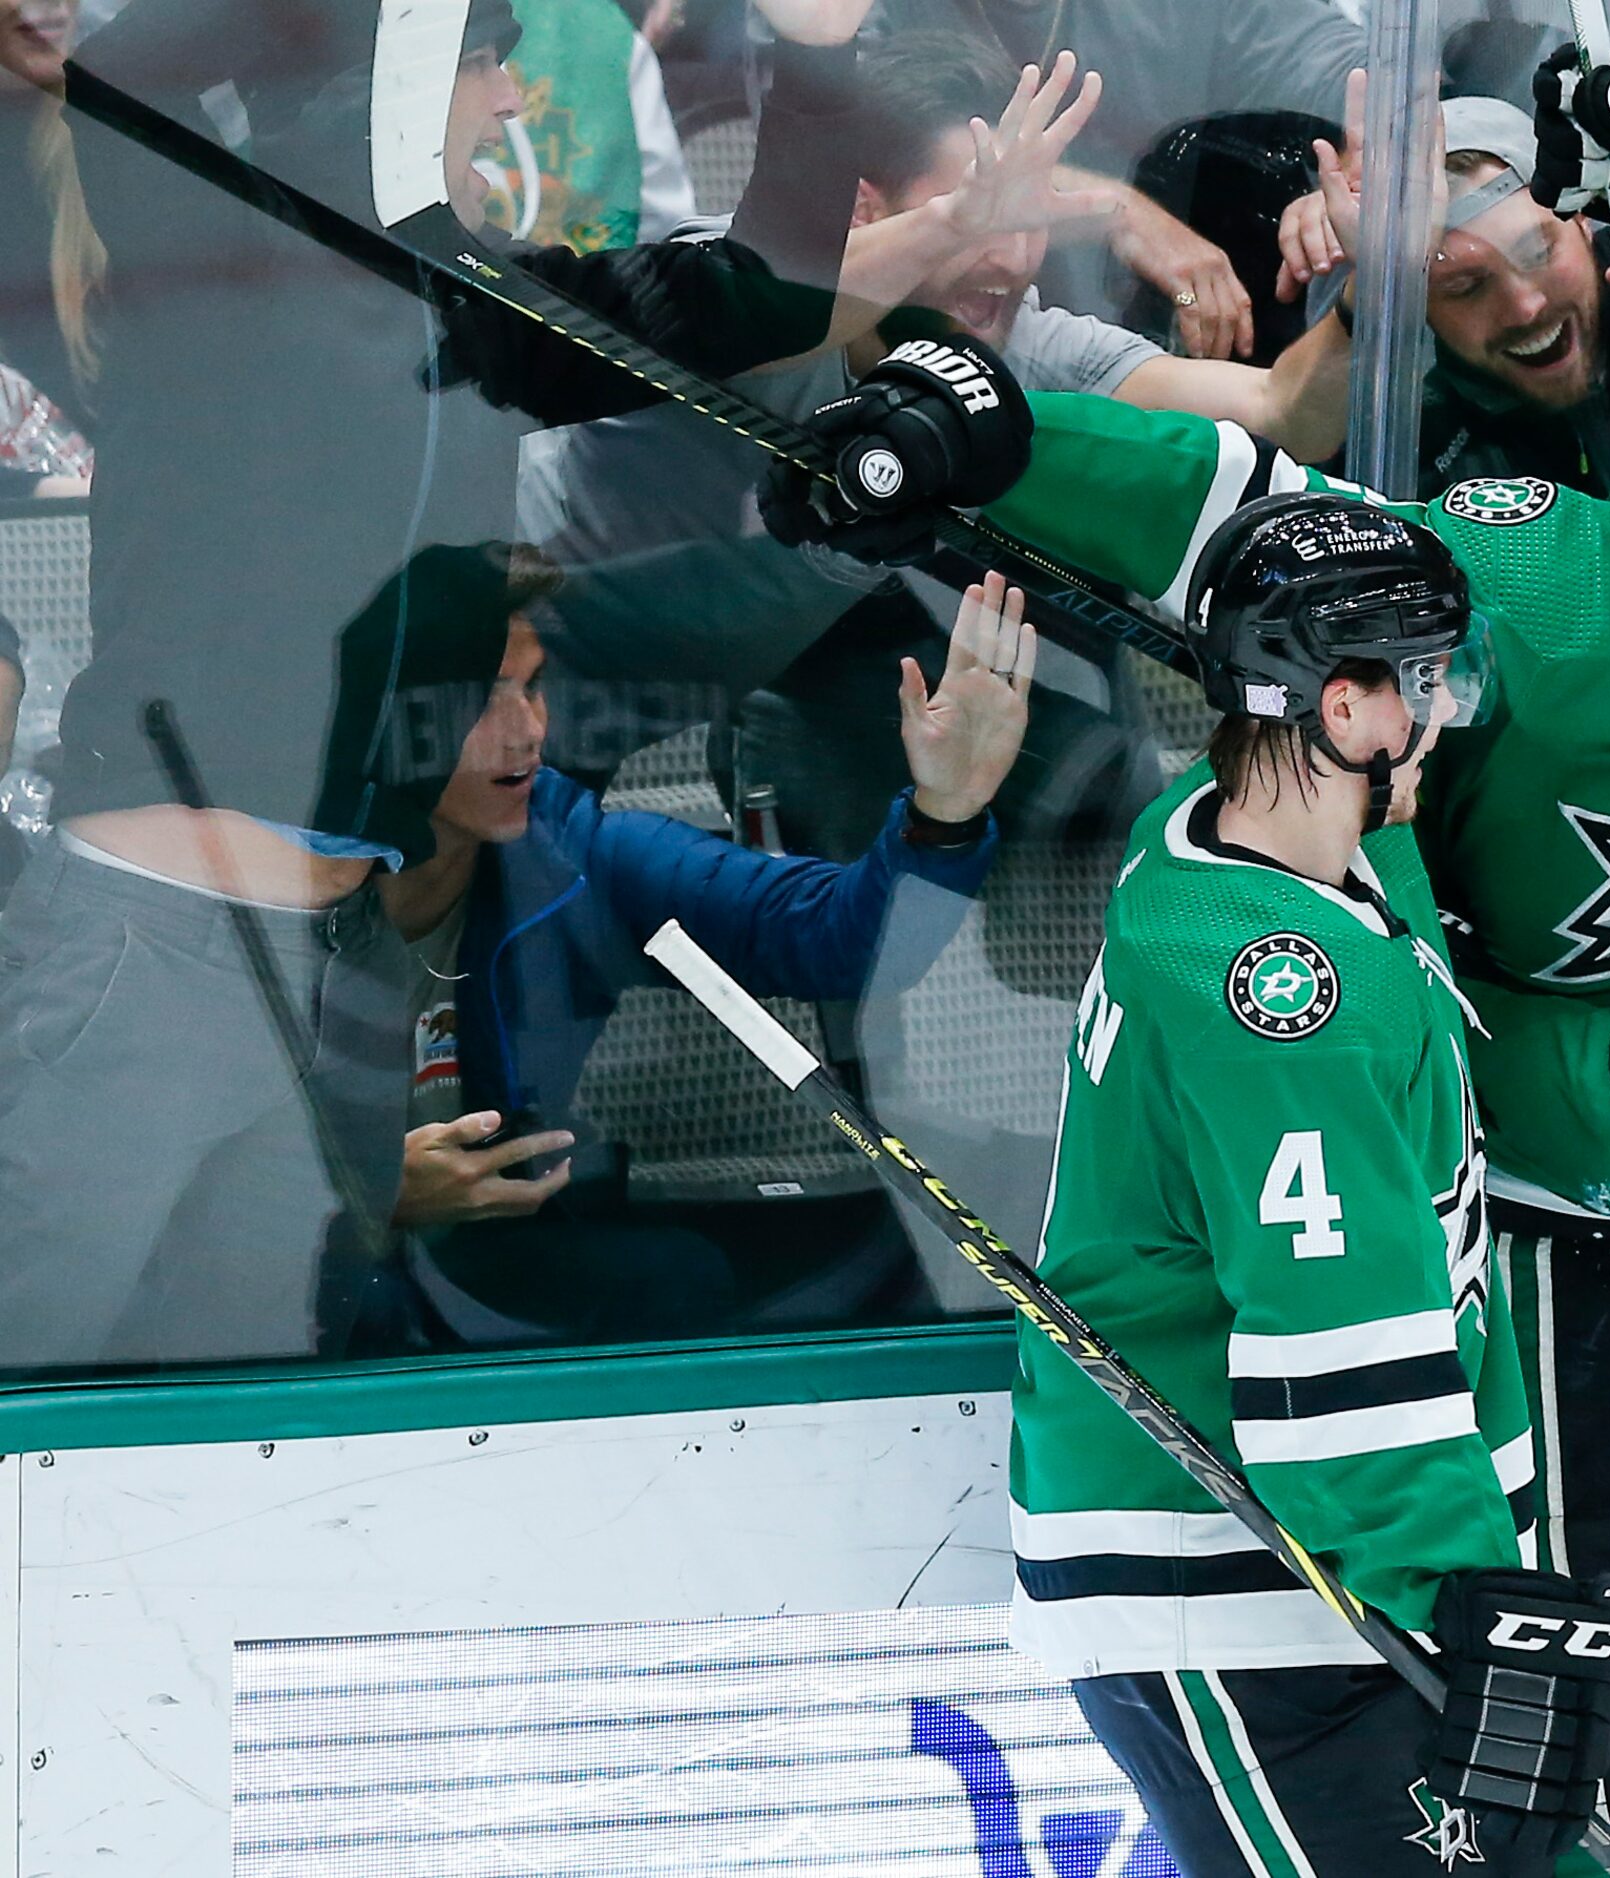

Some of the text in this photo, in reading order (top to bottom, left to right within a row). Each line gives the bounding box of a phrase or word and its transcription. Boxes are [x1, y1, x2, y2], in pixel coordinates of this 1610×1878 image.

[1330, 540, 1392, 555] TRANSFER
[1236, 940, 1330, 981] DALLAS
[1240, 1000, 1326, 1032] STARS
[880, 1136, 1012, 1253] CCM
[1259, 1129, 1346, 1260] 4
[956, 1240, 1071, 1344] SUPER
[1039, 1282, 1091, 1333] HEISKANEN
